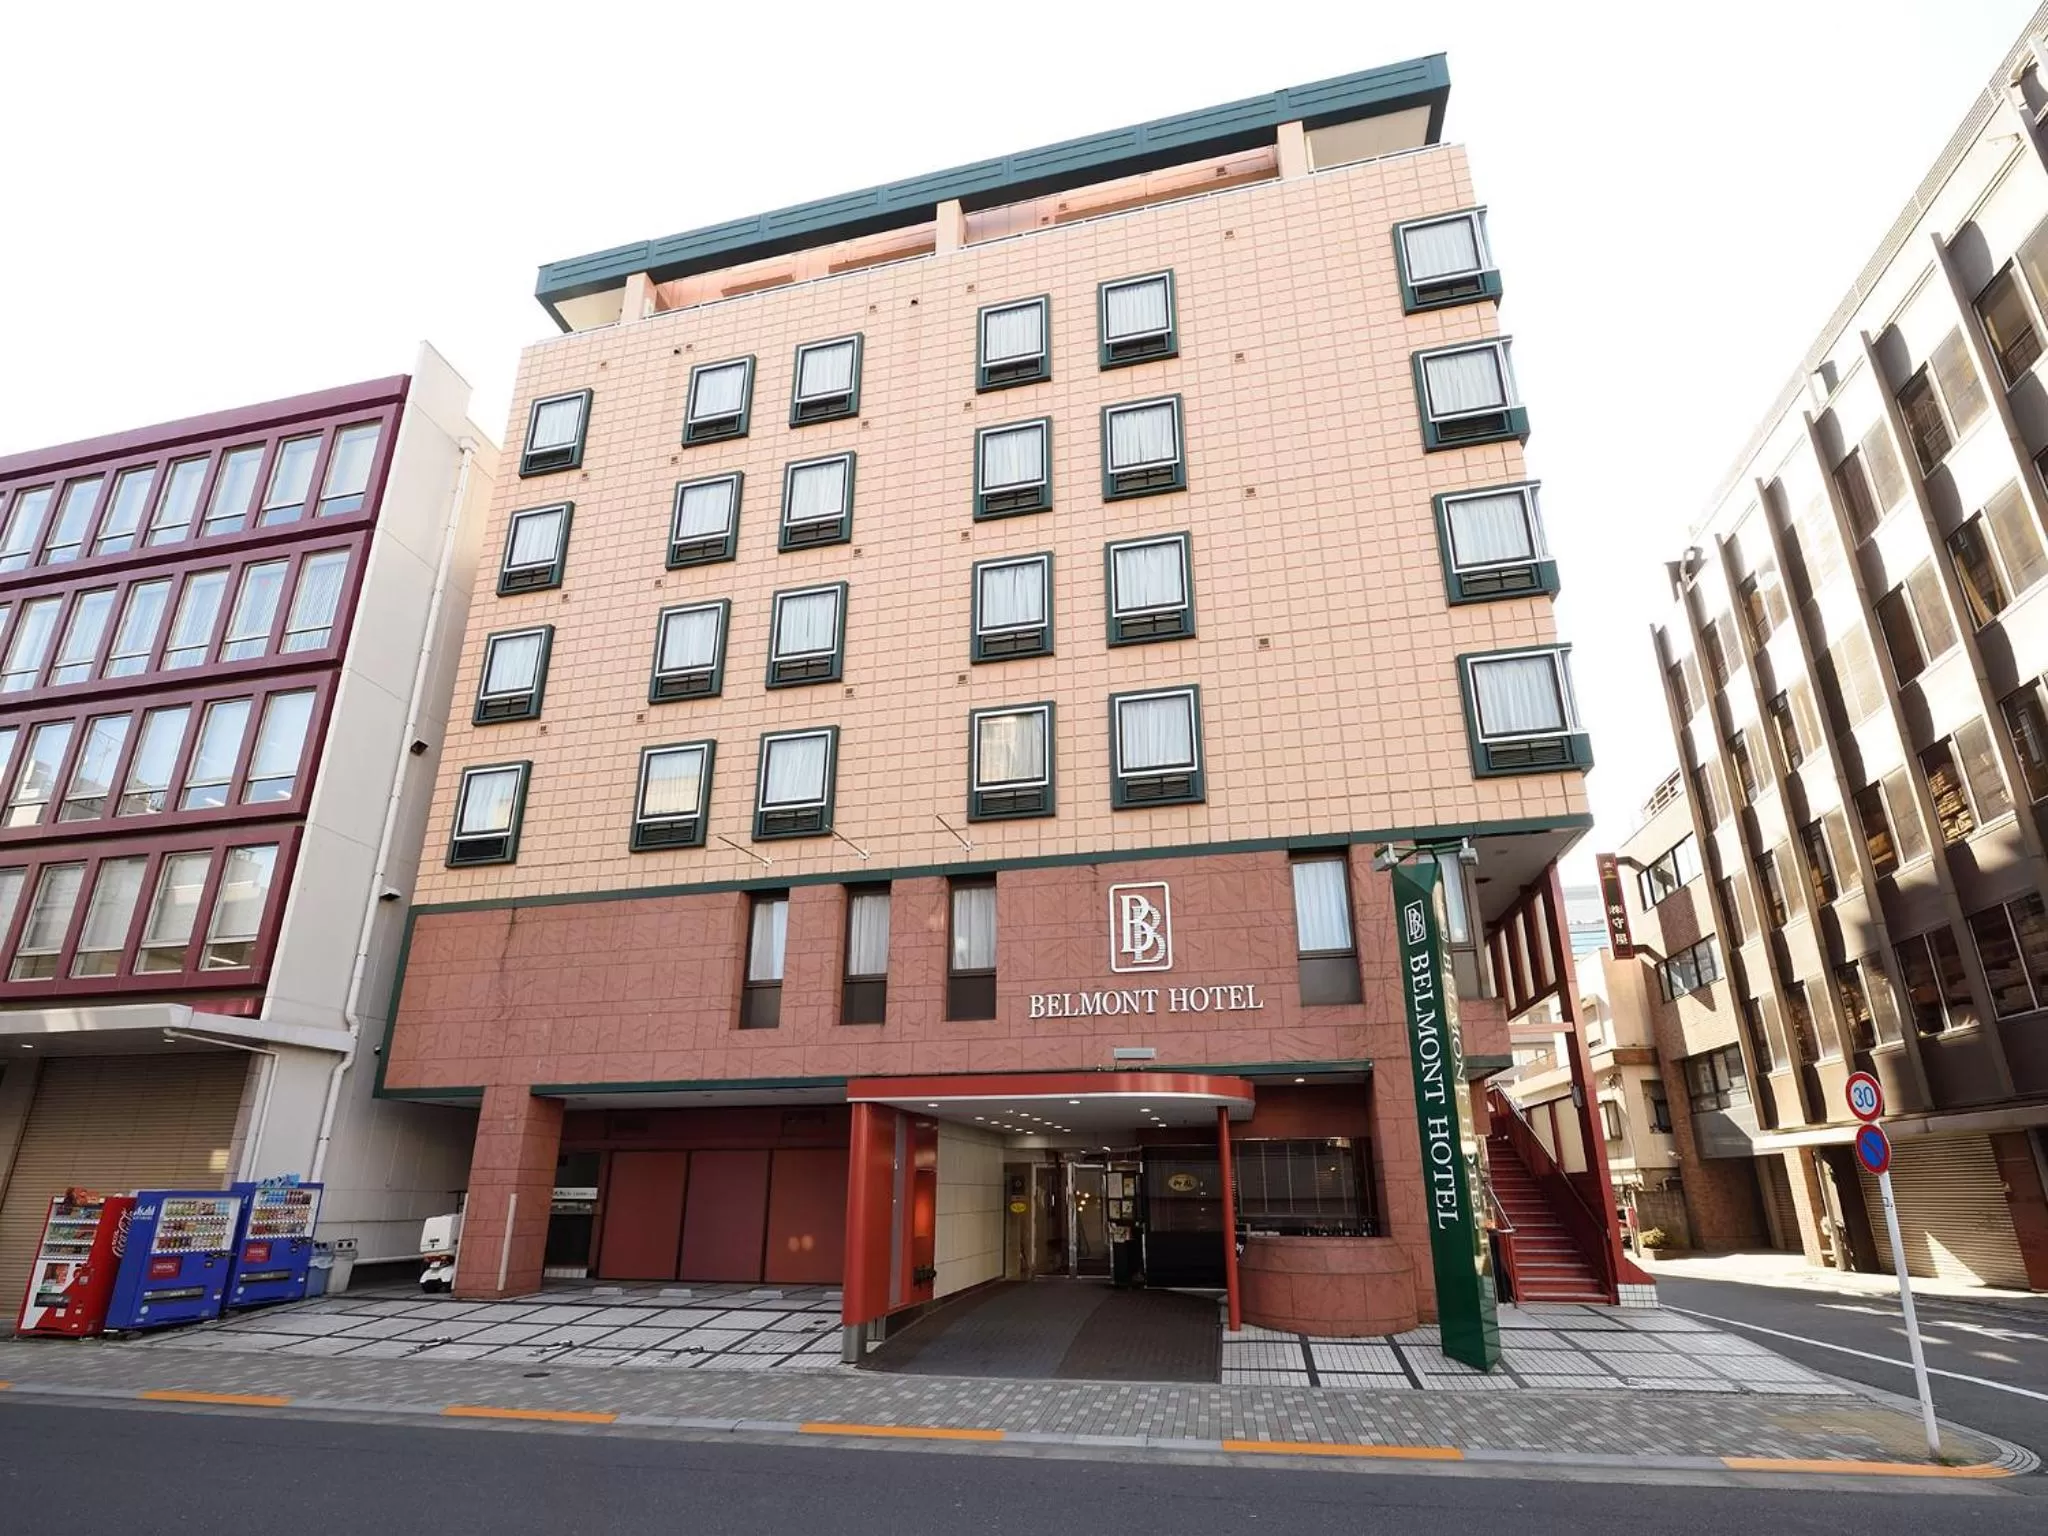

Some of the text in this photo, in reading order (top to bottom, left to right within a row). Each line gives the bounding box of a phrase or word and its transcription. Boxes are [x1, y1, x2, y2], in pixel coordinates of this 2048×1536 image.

[1029, 984, 1264, 1018] BELMONT HOTEL
[1410, 951, 1459, 1229] BELMONT HOTEL
[1853, 1086, 1875, 1108] 30
